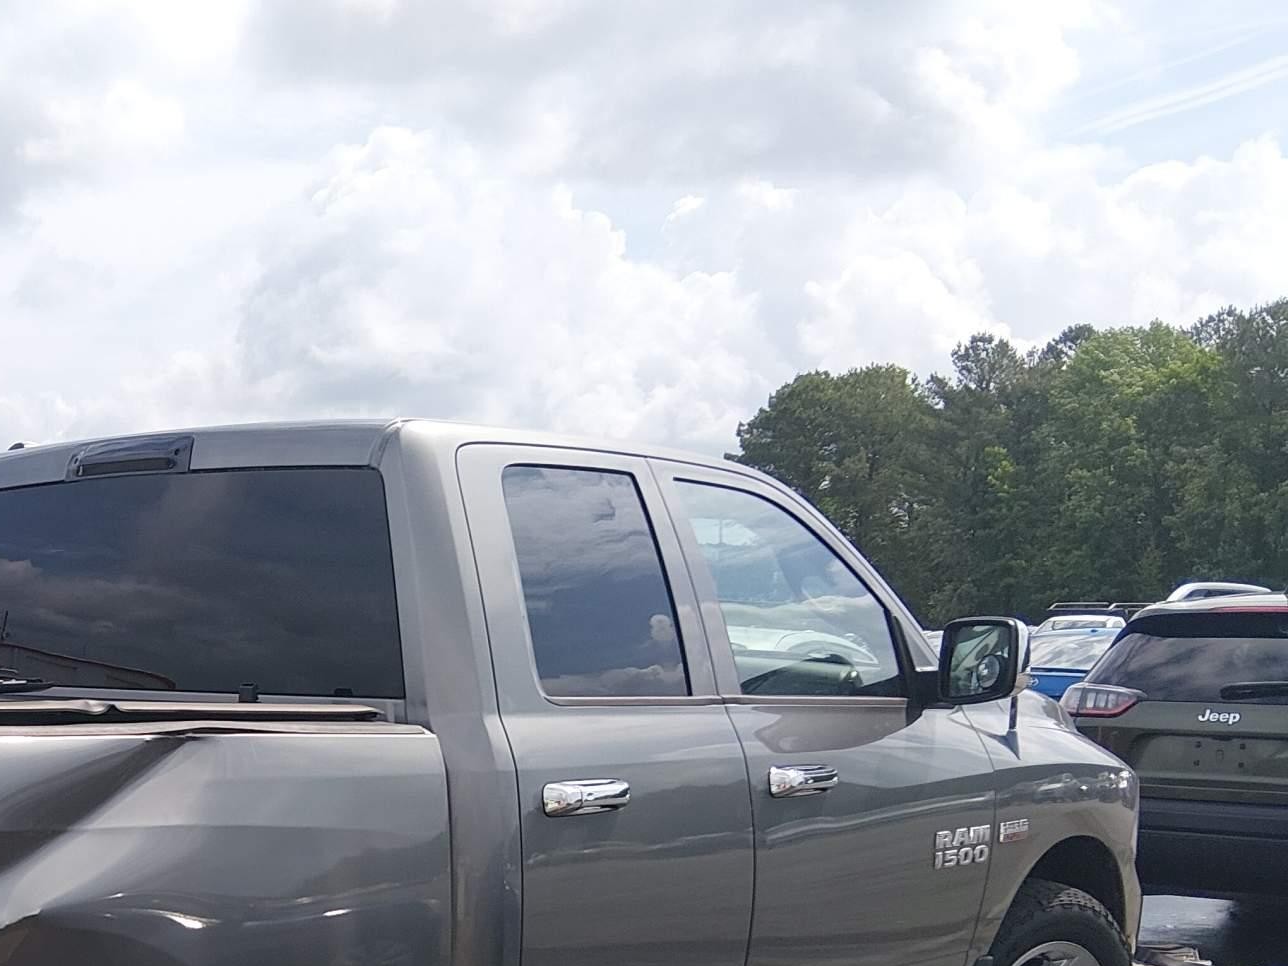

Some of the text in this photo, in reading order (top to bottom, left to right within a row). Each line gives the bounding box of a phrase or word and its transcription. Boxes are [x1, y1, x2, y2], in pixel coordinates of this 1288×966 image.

[1198, 708, 1241, 725] Jeep
[935, 824, 991, 850] RAM
[934, 845, 990, 870] 1500
